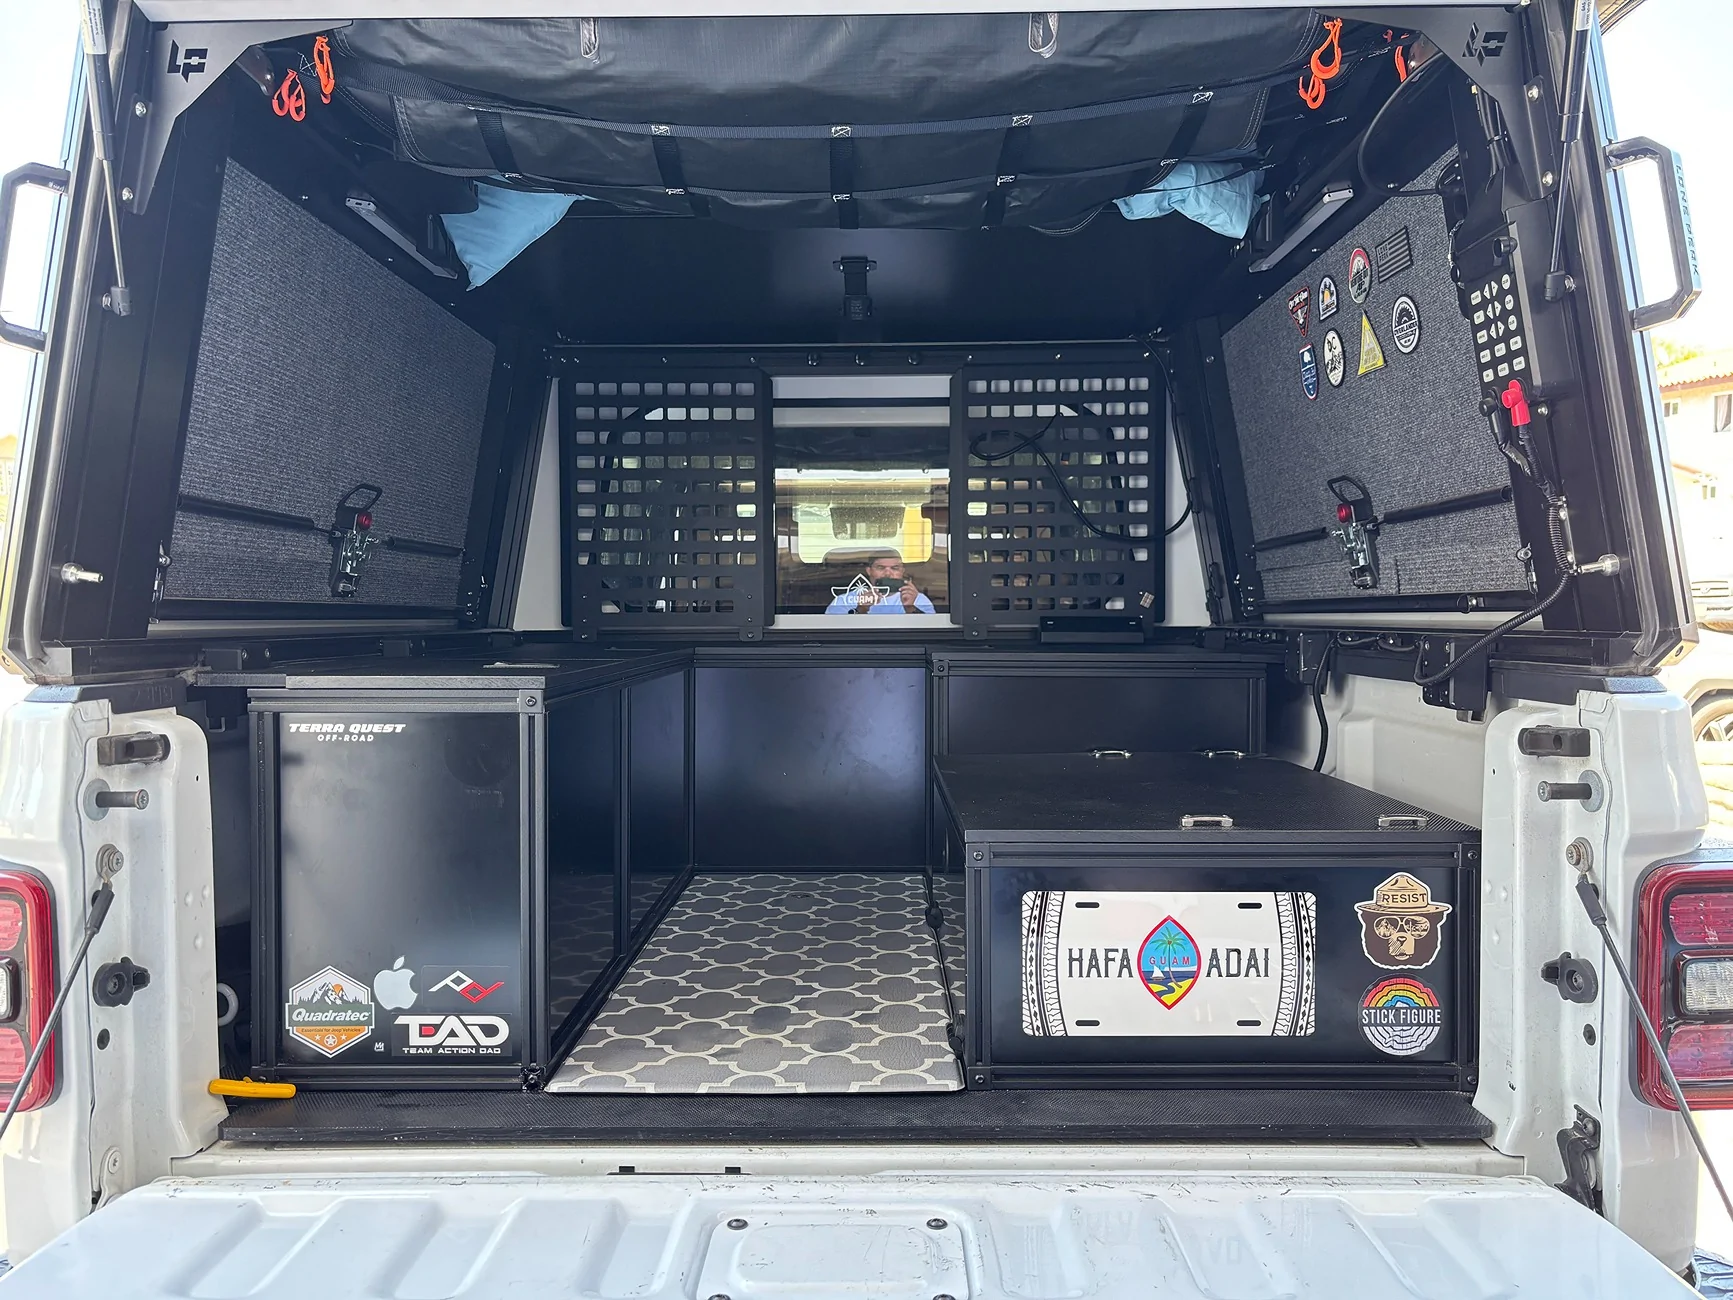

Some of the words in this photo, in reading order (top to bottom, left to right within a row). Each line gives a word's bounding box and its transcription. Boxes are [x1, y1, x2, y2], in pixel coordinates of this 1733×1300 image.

[1675, 164, 1690, 216] LONE
[1685, 222, 1699, 275] PEAK
[848, 595, 873, 604] GUAM
[289, 723, 345, 733] TERRA
[349, 723, 406, 733] QUEST
[317, 734, 374, 742] OFF-ROAD
[1382, 893, 1427, 904] RESIST
[1068, 948, 1134, 979] HAFA
[1206, 948, 1270, 979] ADAI
[1149, 956, 1191, 966] GUAM
[292, 1007, 370, 1022] Quadratec
[1362, 1008, 1396, 1024] STICK
[1400, 1008, 1441, 1024] FIGURE
